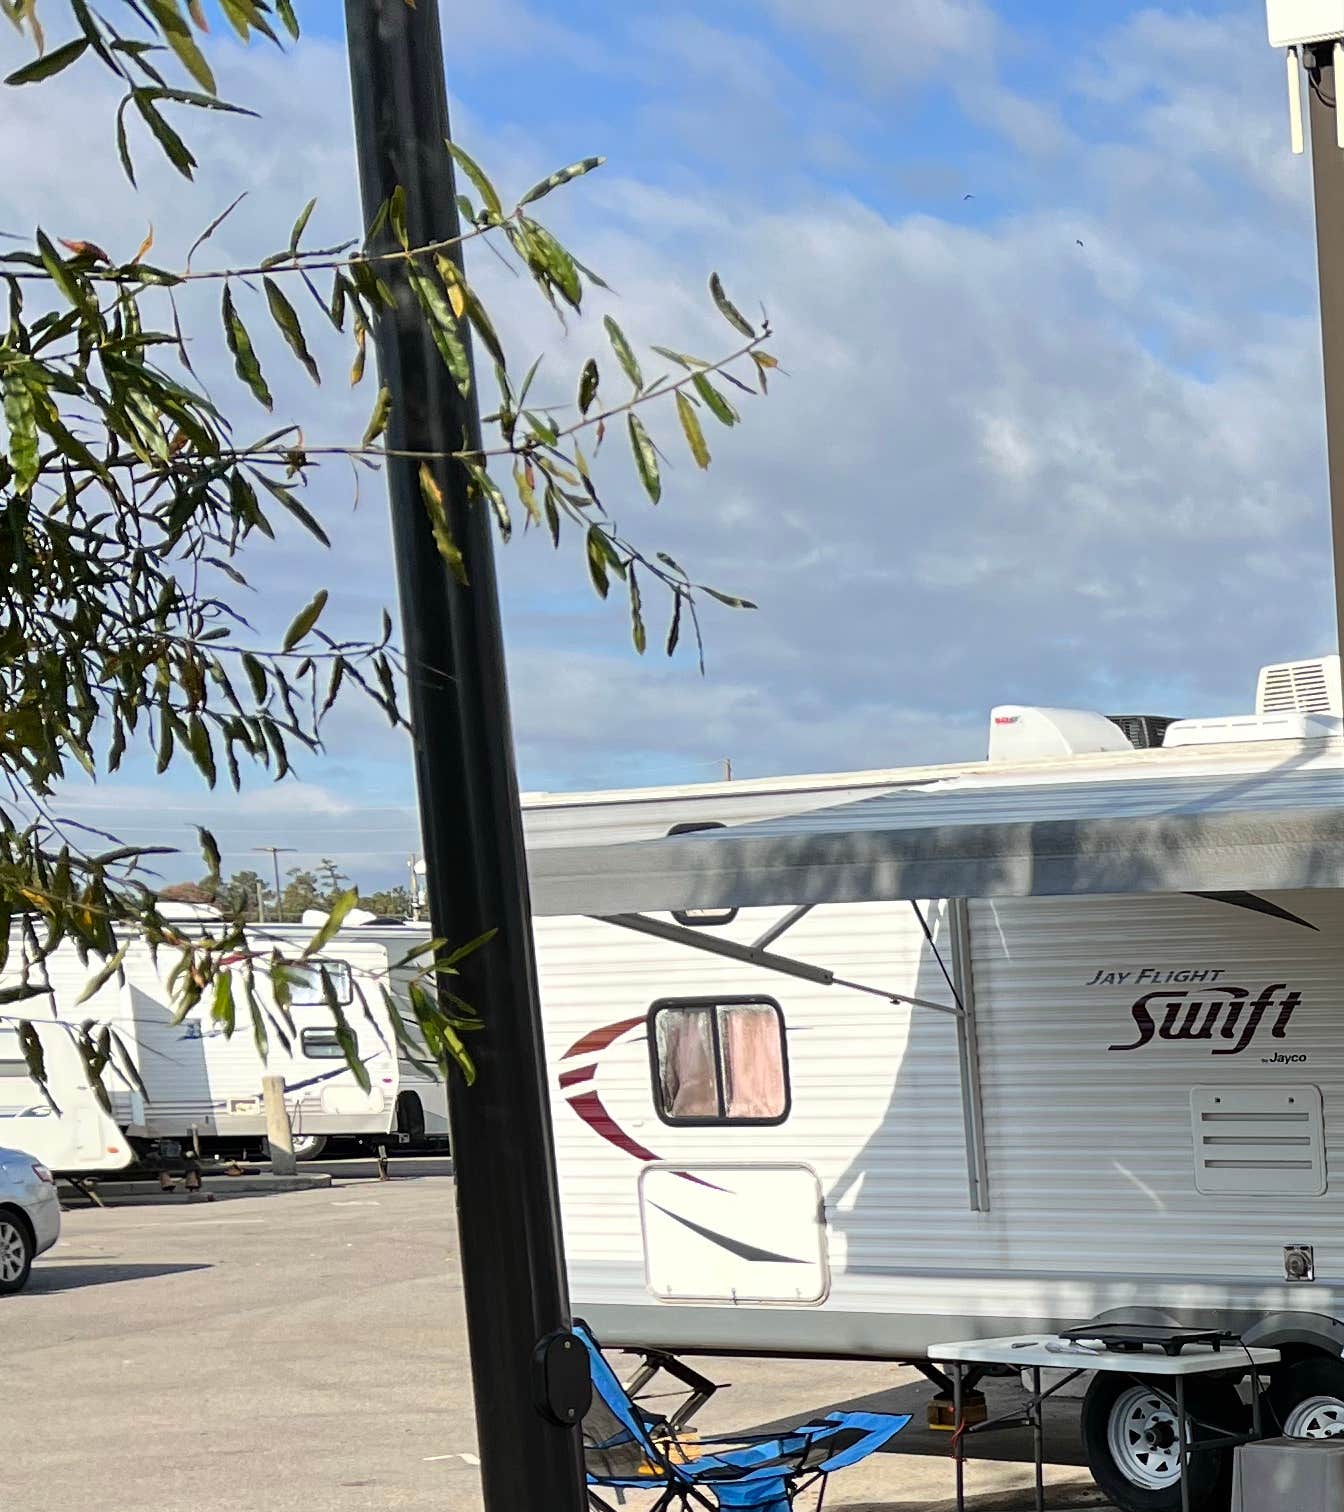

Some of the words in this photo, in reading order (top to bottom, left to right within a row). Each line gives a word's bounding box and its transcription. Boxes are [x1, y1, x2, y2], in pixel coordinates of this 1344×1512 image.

[1086, 969, 1131, 986] JAY
[1108, 983, 1302, 1055] Swift
[1270, 1052, 1307, 1065] Jayco
